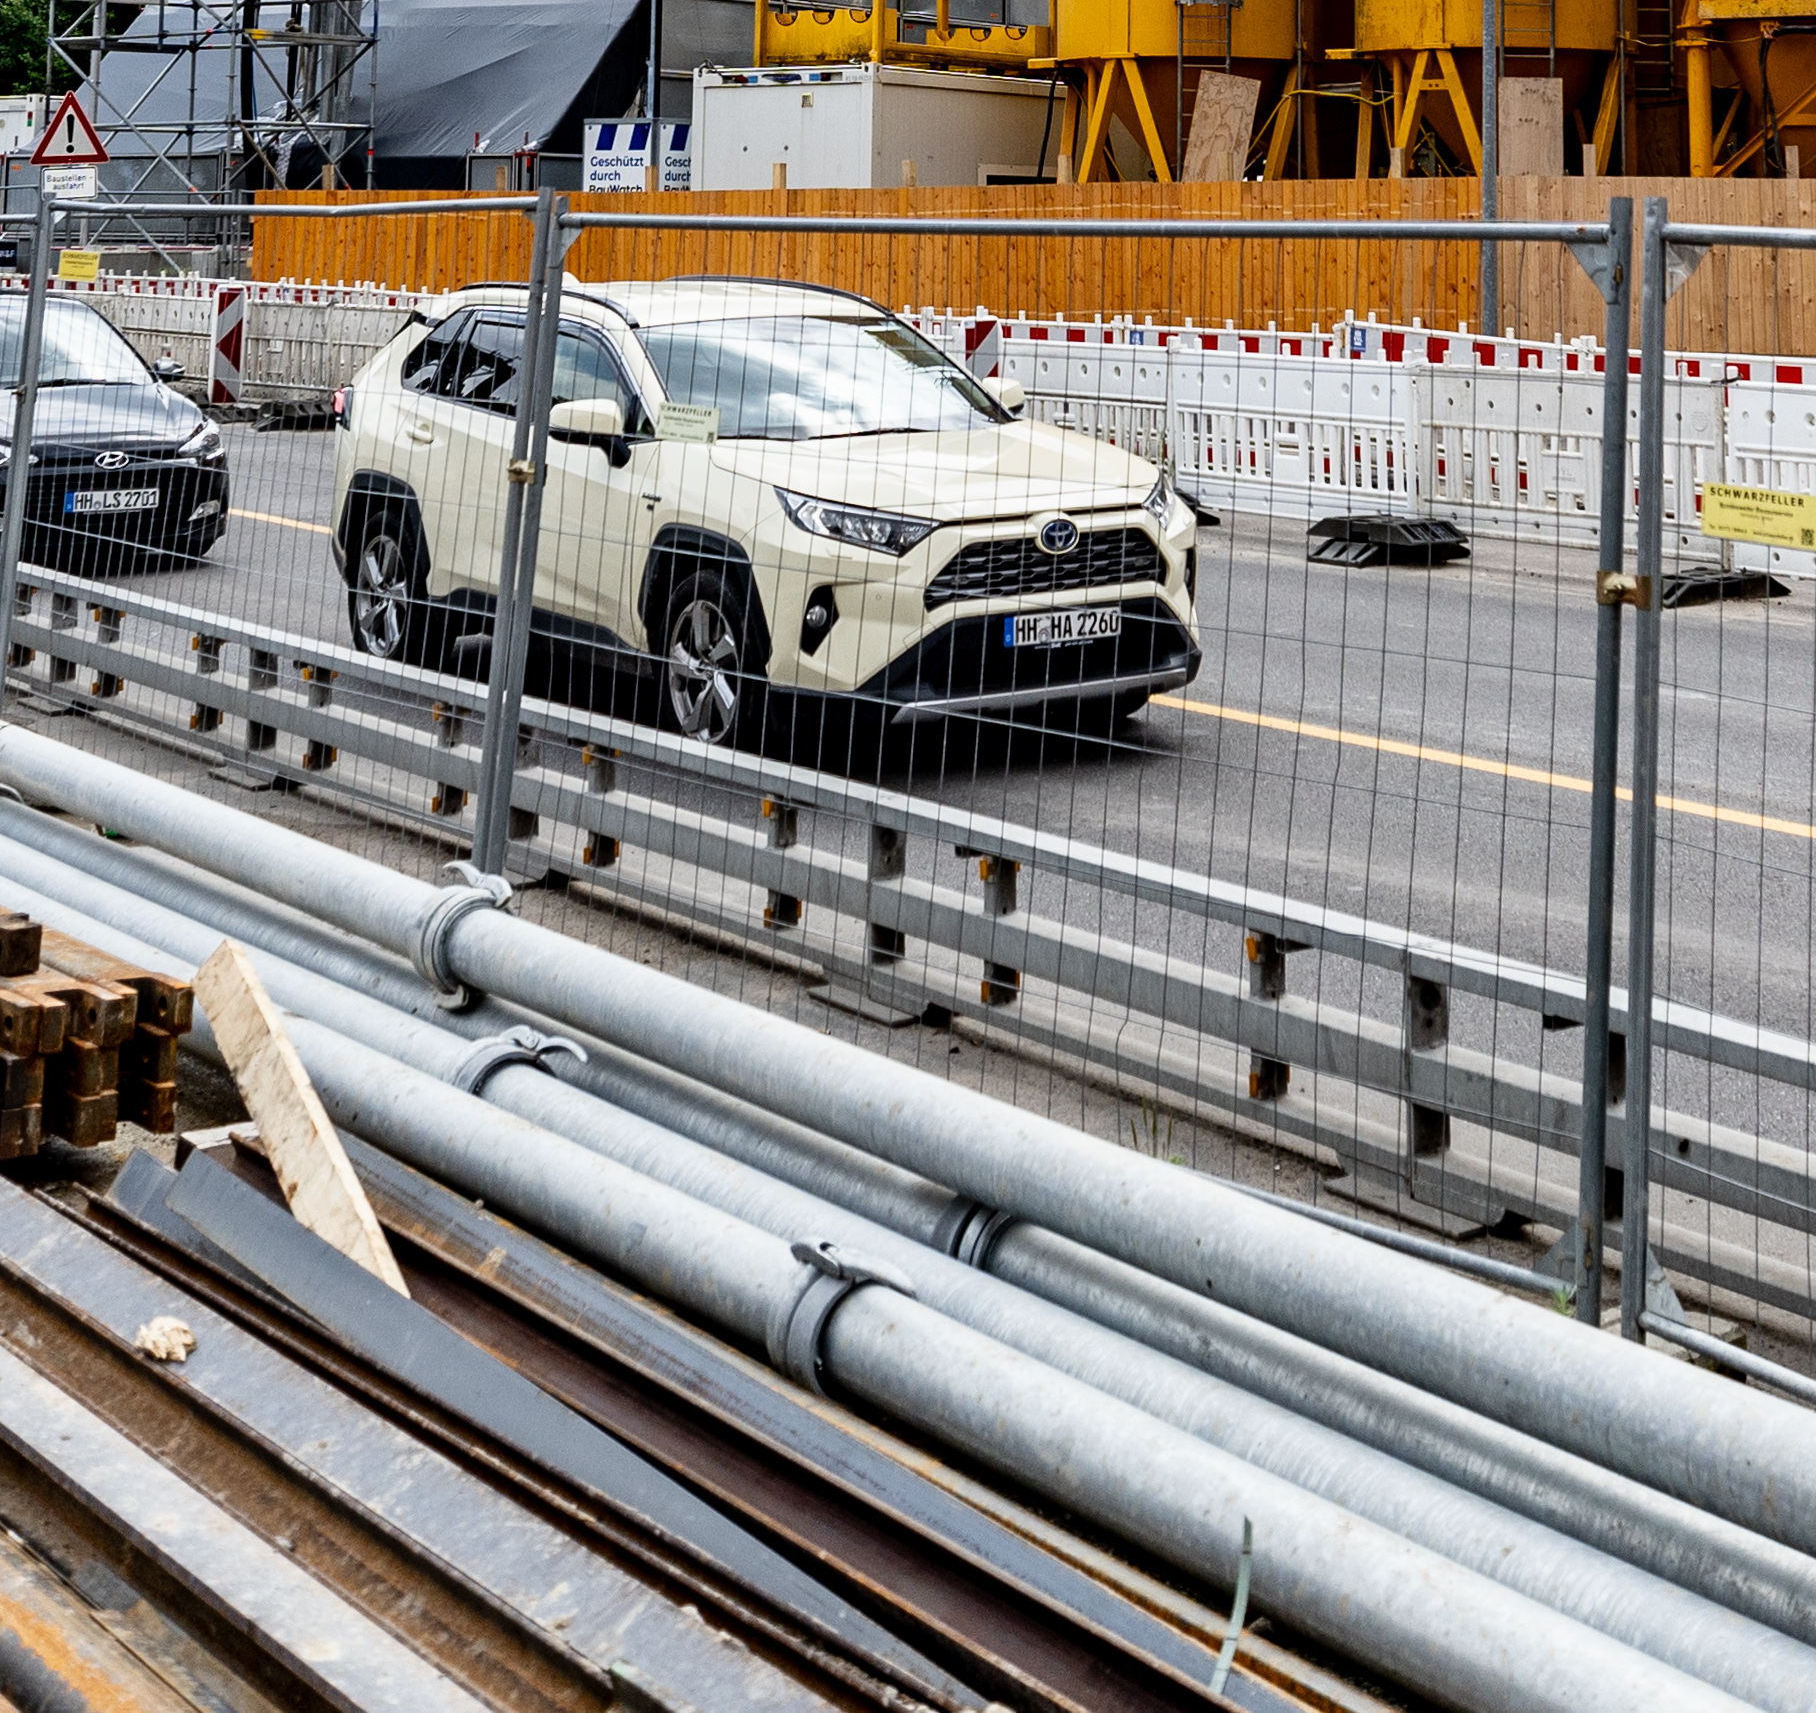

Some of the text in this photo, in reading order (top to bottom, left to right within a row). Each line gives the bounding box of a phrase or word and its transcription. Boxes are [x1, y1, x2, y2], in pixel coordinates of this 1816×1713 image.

[590, 155, 644, 167] Geschützt
[590, 170, 621, 181] durch
[74, 491, 158, 510] HH LS 2701
[1710, 487, 1805, 507] SCHWARZFELLER
[1015, 617, 1038, 643] HH
[1051, 614, 1073, 640] HA
